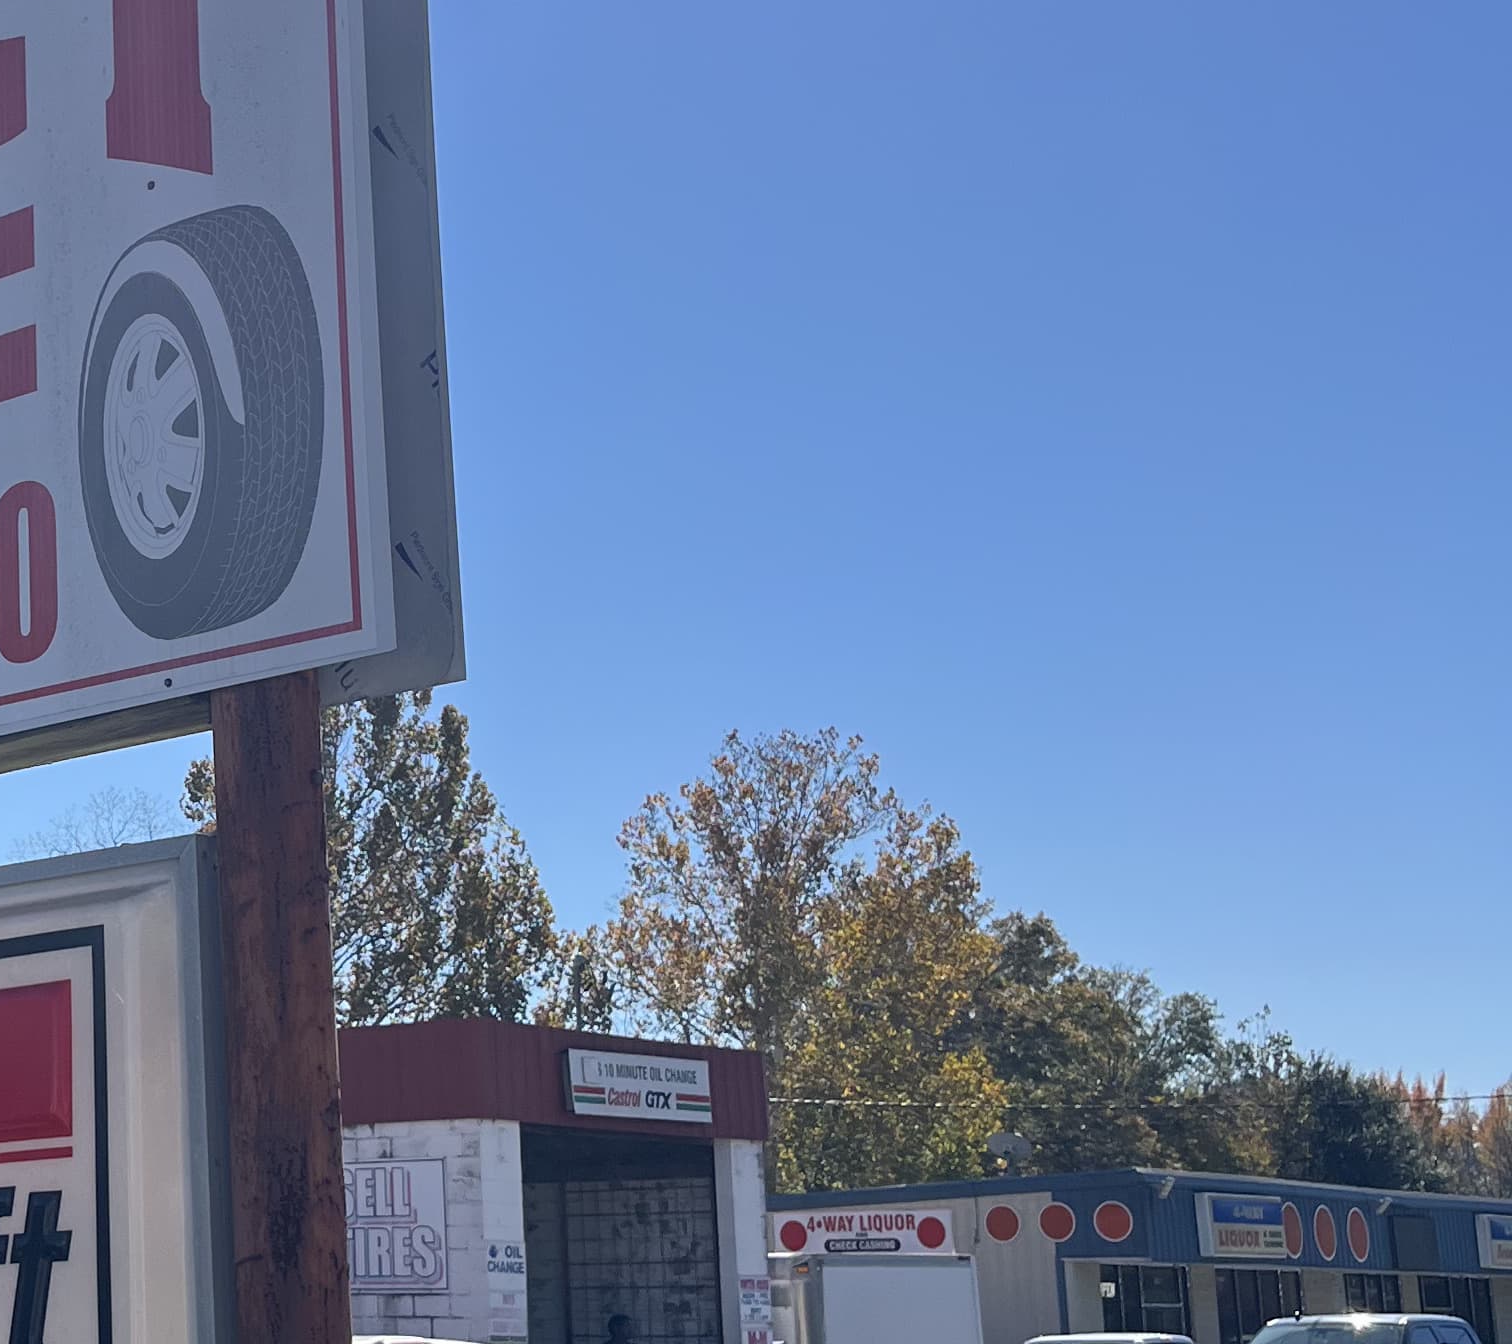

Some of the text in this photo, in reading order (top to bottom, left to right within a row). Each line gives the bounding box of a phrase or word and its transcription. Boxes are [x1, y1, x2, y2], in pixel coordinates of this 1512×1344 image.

[649, 1066, 663, 1082] OIL
[664, 1067, 697, 1085] CHANGE
[607, 1087, 673, 1110] Castrol GTX
[859, 1214, 916, 1233] LIQUOR
[1218, 1230, 1260, 1248] LIQUOR
[504, 1245, 524, 1259] OIL
[487, 1260, 525, 1274] CHANGE
